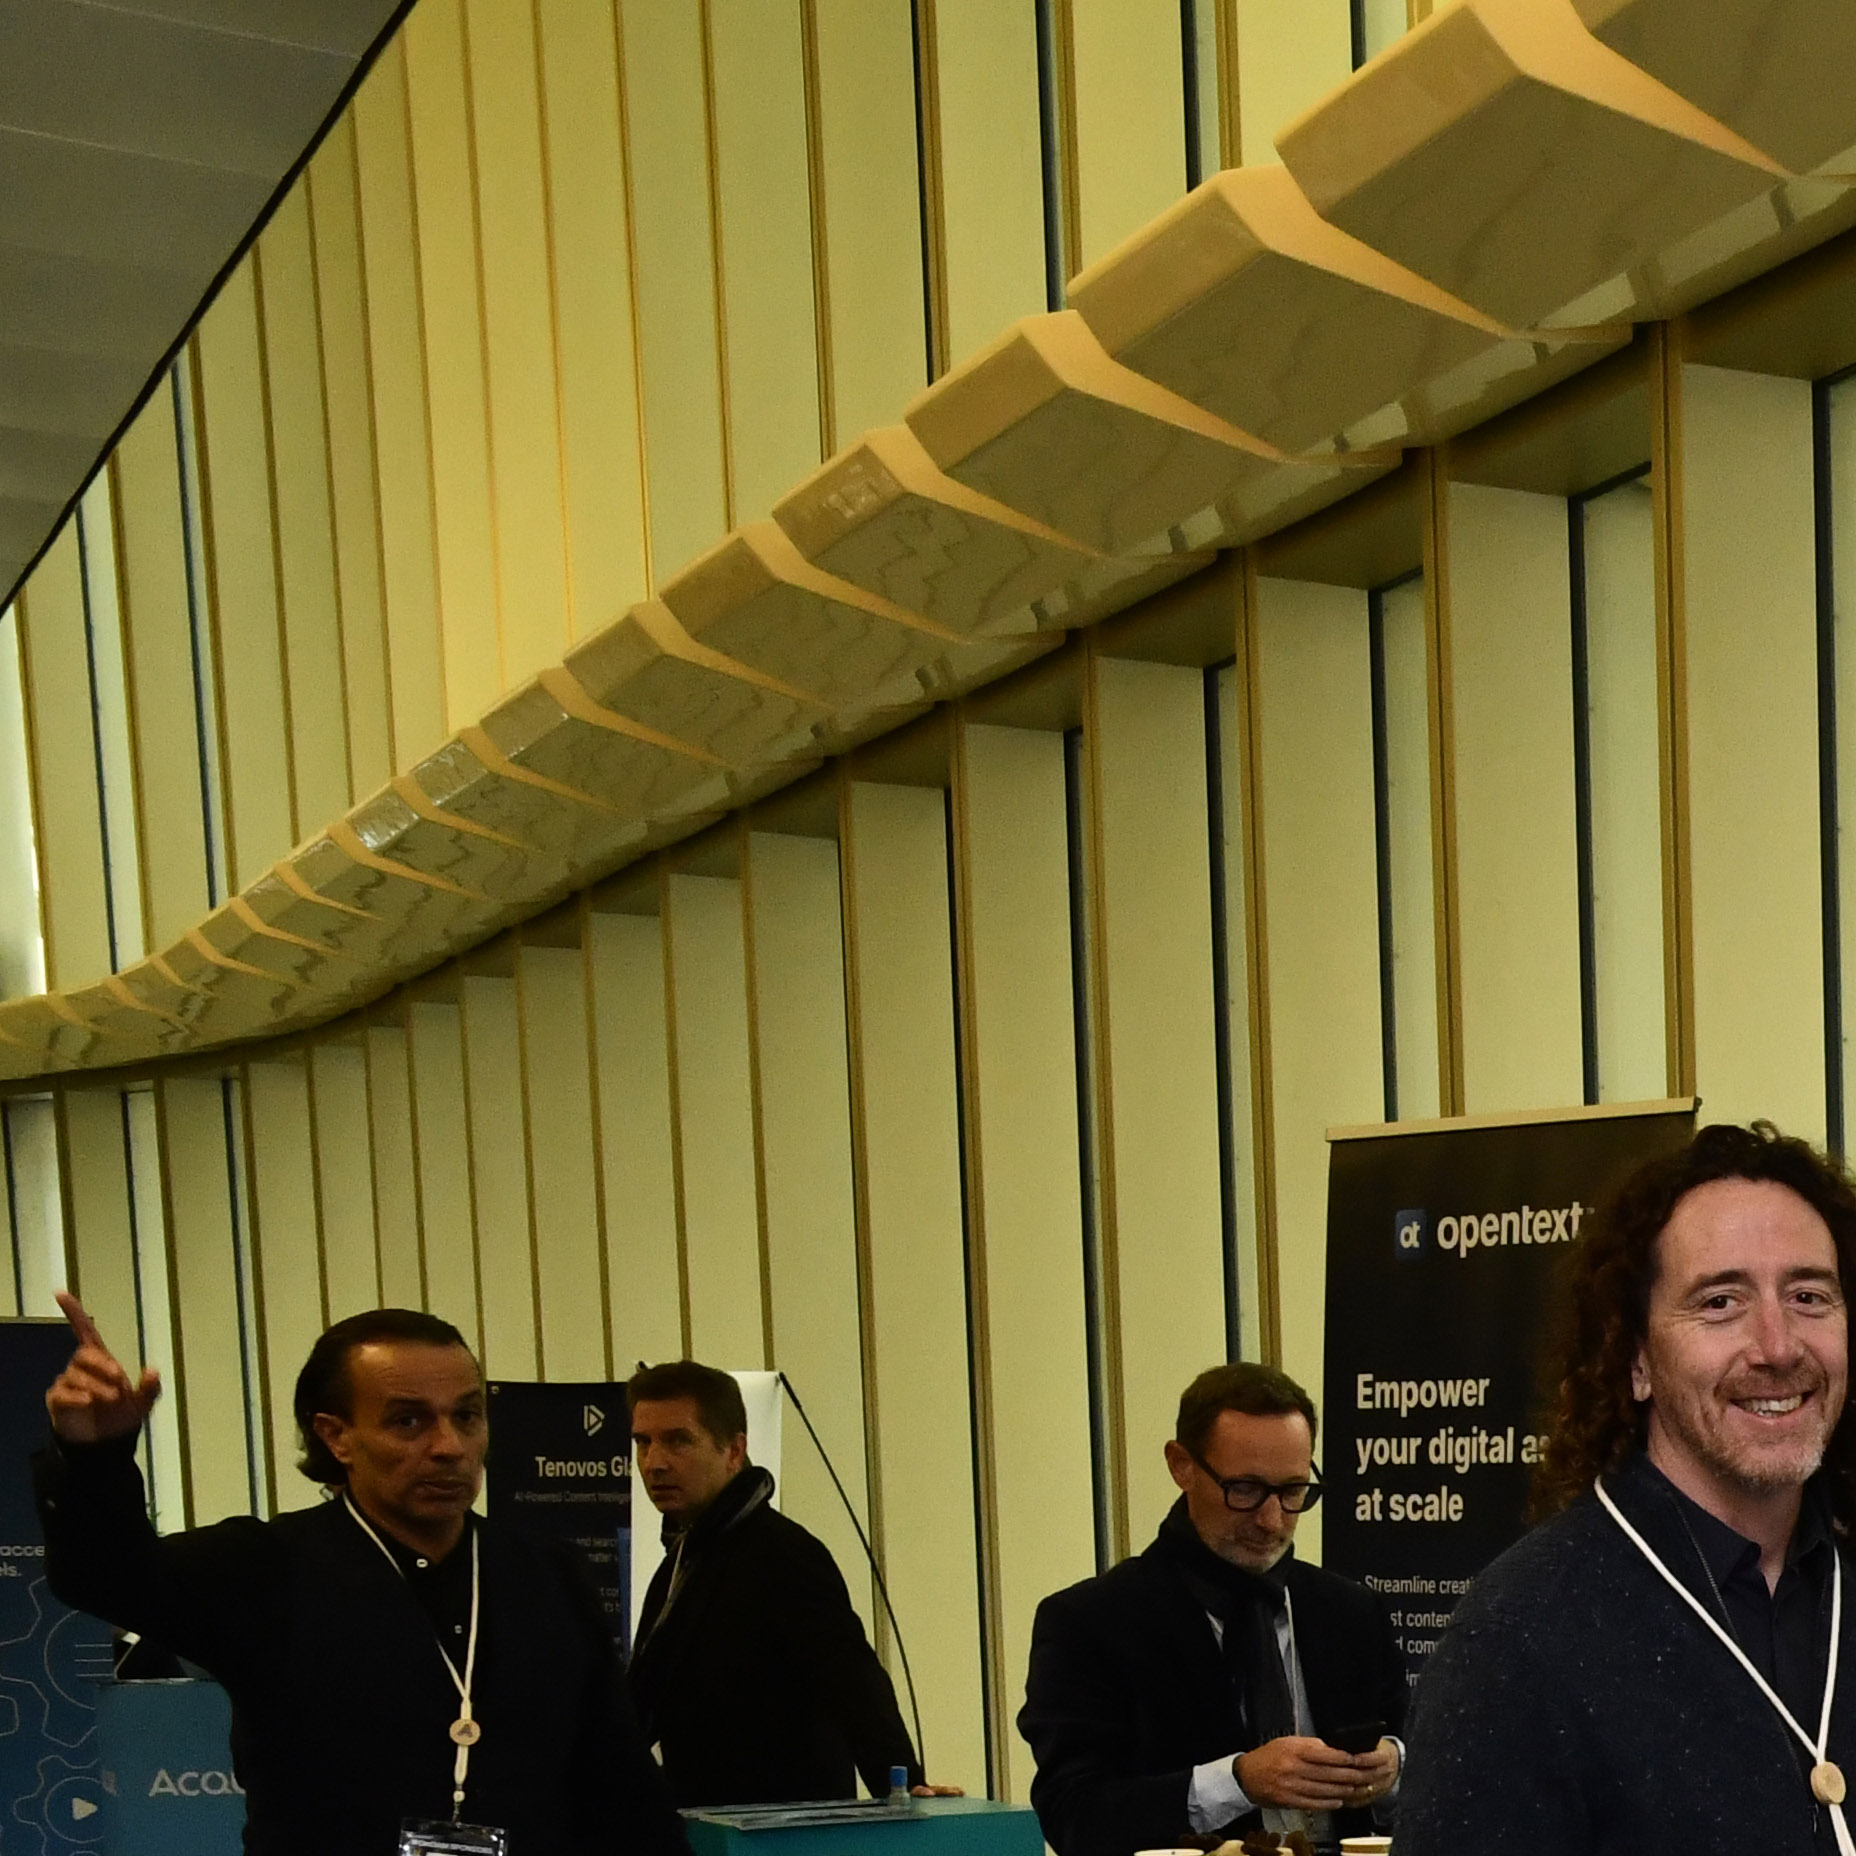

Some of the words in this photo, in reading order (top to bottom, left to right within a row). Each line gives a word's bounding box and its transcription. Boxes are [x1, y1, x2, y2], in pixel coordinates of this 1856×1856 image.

[1436, 1201, 1584, 1259] opentext
[1356, 1373, 1491, 1418] Empower
[534, 1455, 607, 1478] Tenovos
[1355, 1437, 1423, 1475] your
[1428, 1425, 1515, 1475] digital
[1355, 1487, 1384, 1522] at
[1388, 1484, 1464, 1522] scale
[1364, 1574, 1436, 1594] Streamline
